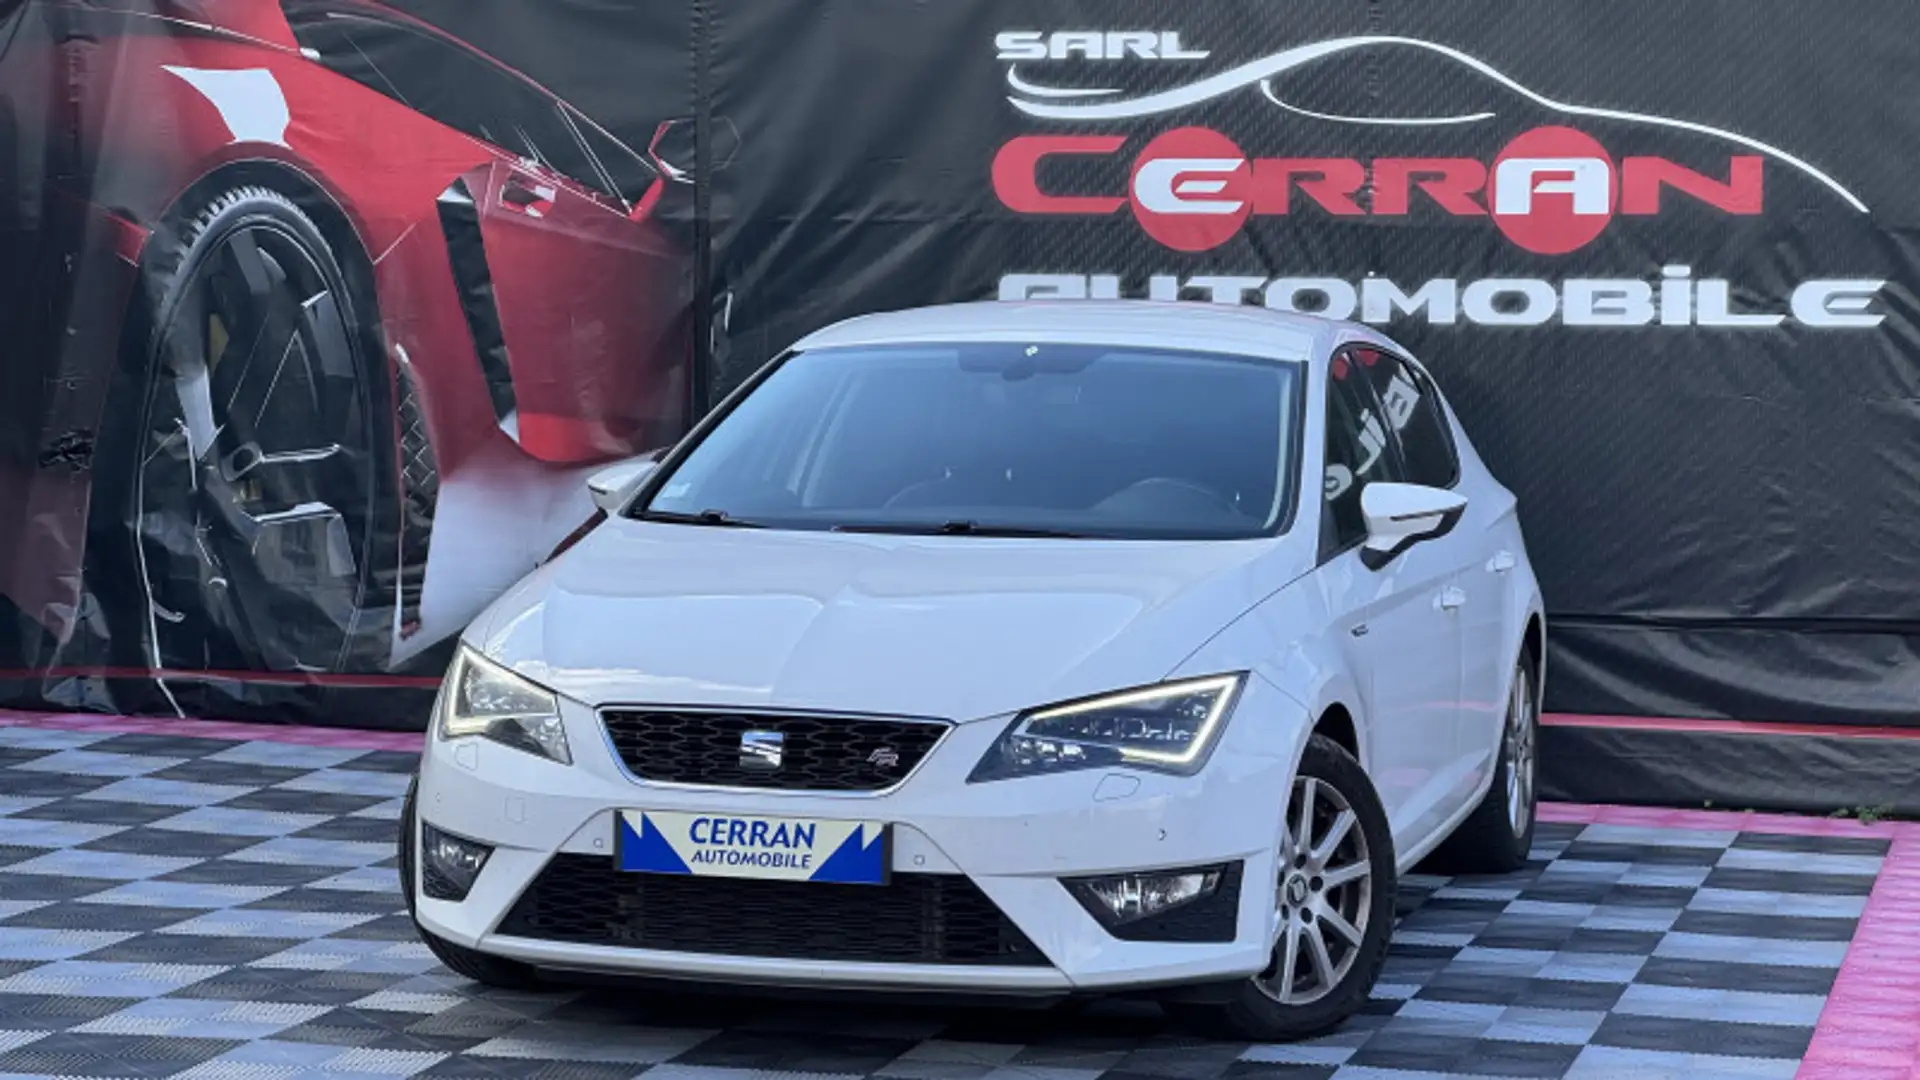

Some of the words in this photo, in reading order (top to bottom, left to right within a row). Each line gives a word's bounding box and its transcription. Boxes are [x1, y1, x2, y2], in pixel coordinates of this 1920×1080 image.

[995, 31, 1210, 59] SARL
[991, 134, 1764, 216] CERRAN
[688, 817, 816, 850] CERRAN
[690, 850, 813, 870] AUTOMOBILE
